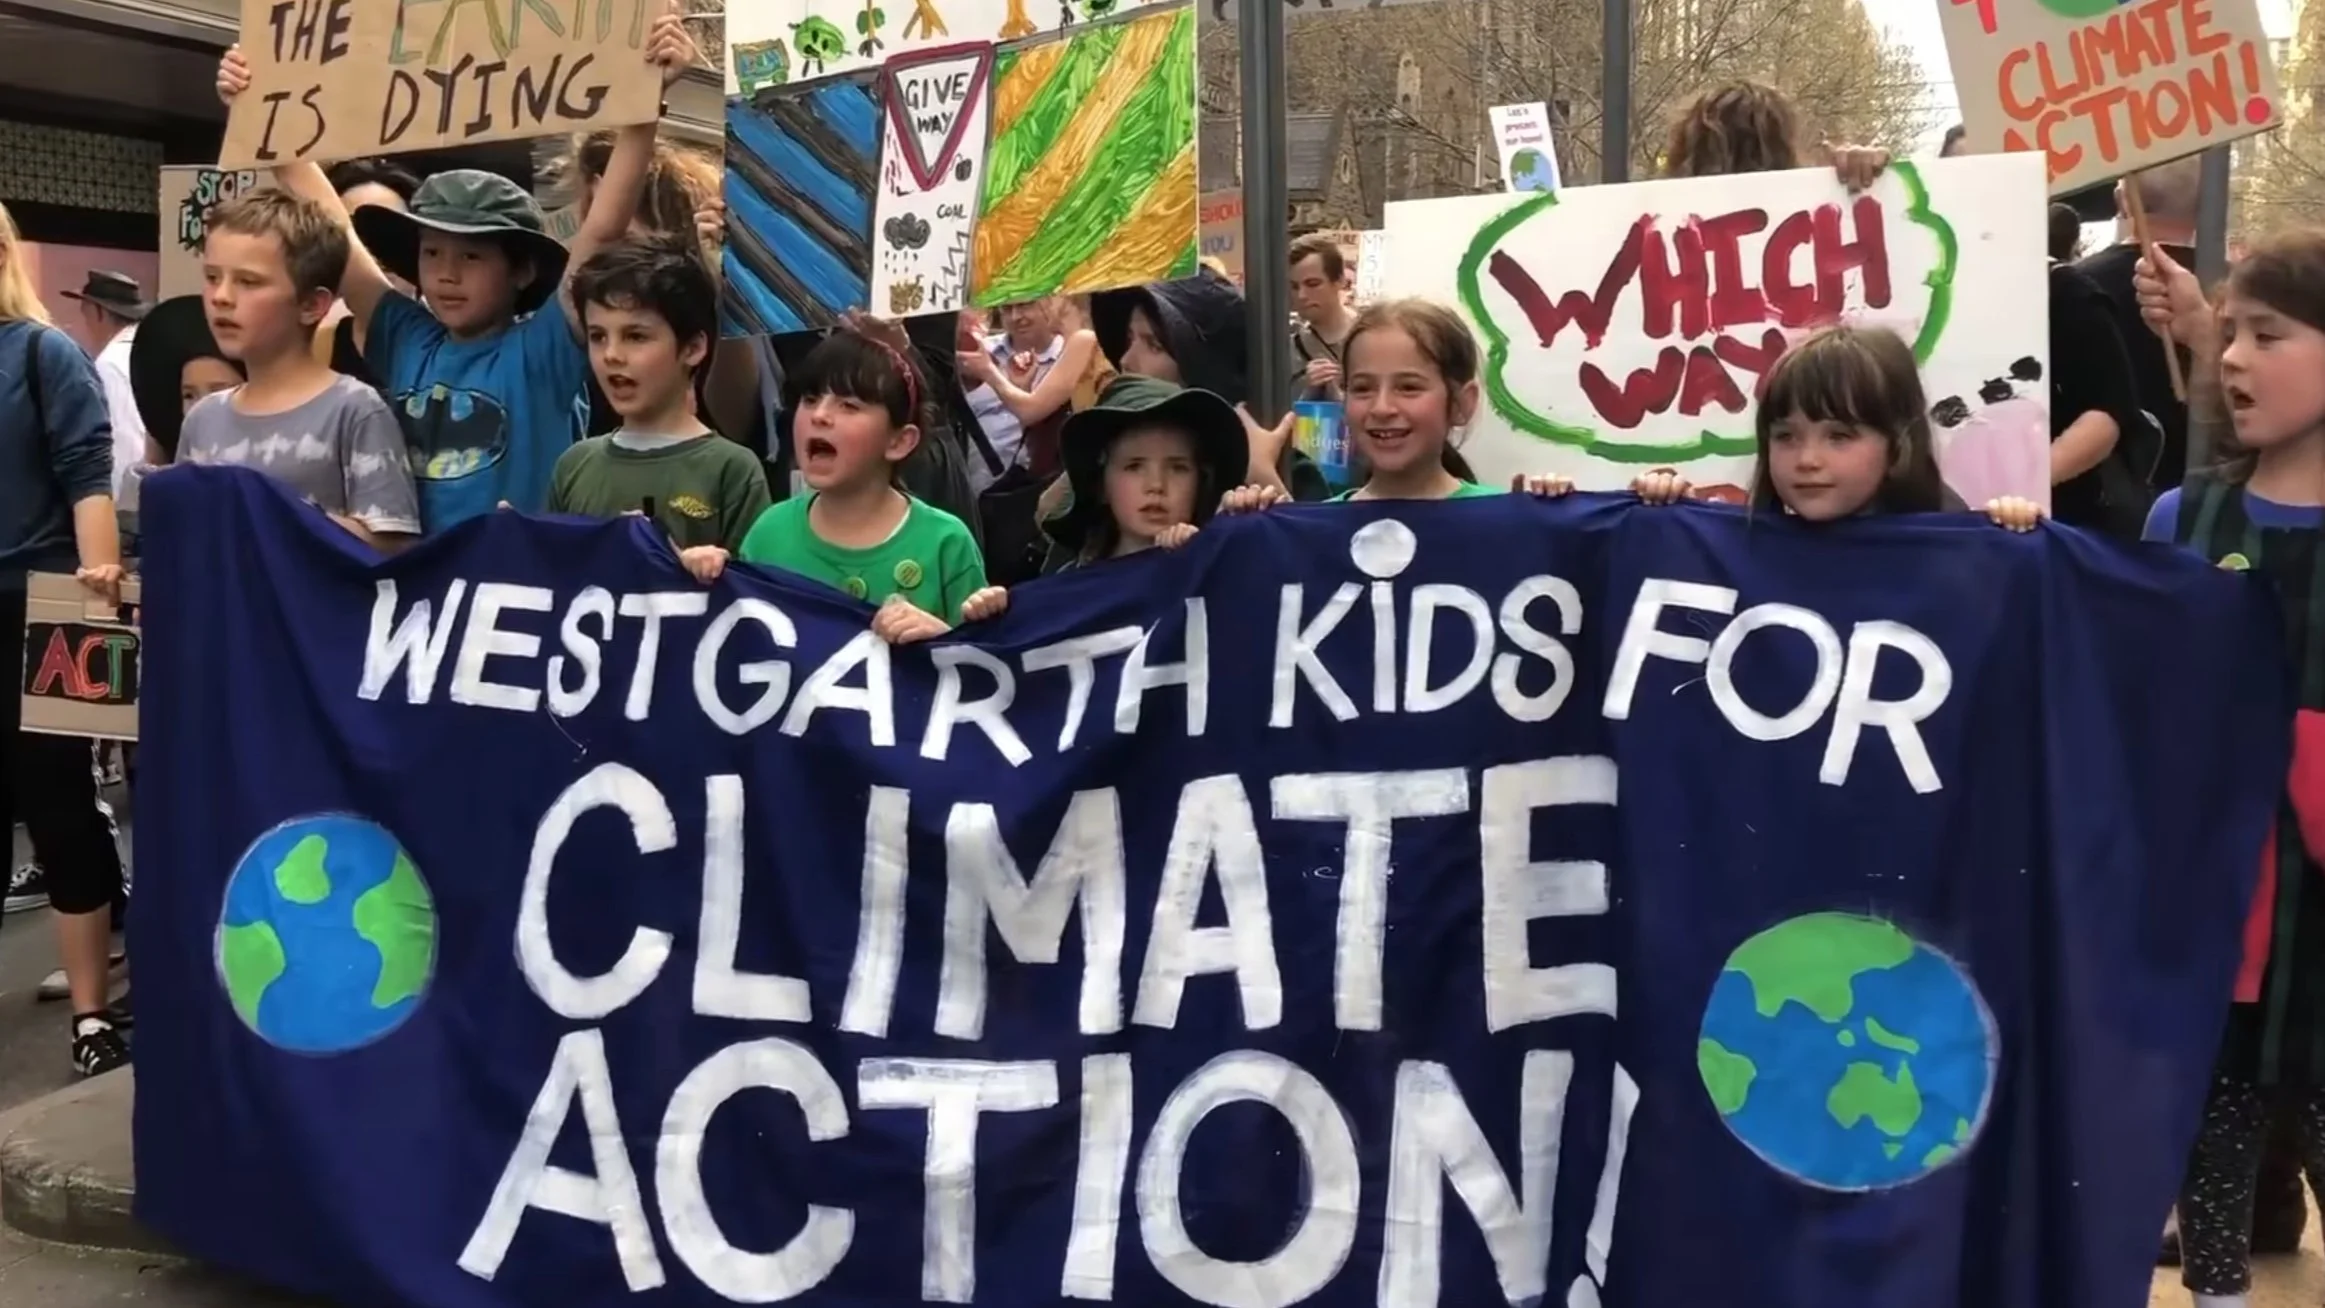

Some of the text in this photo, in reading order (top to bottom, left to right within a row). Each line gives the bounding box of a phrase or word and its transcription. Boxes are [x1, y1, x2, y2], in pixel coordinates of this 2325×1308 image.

[269, 0, 352, 65] THE
[1998, 0, 2232, 122] CLIMATE
[255, 53, 611, 160] IS DYING
[905, 73, 969, 110] GIVE
[917, 112, 954, 135] WAY
[196, 170, 257, 206] STOP
[1489, 195, 1892, 350] WHICH
[1579, 327, 1789, 429] WAY
[31, 627, 138, 698] ACT
[357, 578, 1210, 768] WESTGARTH
[1602, 577, 1952, 794] FOR
[513, 755, 1618, 1040] CLIMATE
[456, 1027, 1641, 1308] ACTION!
